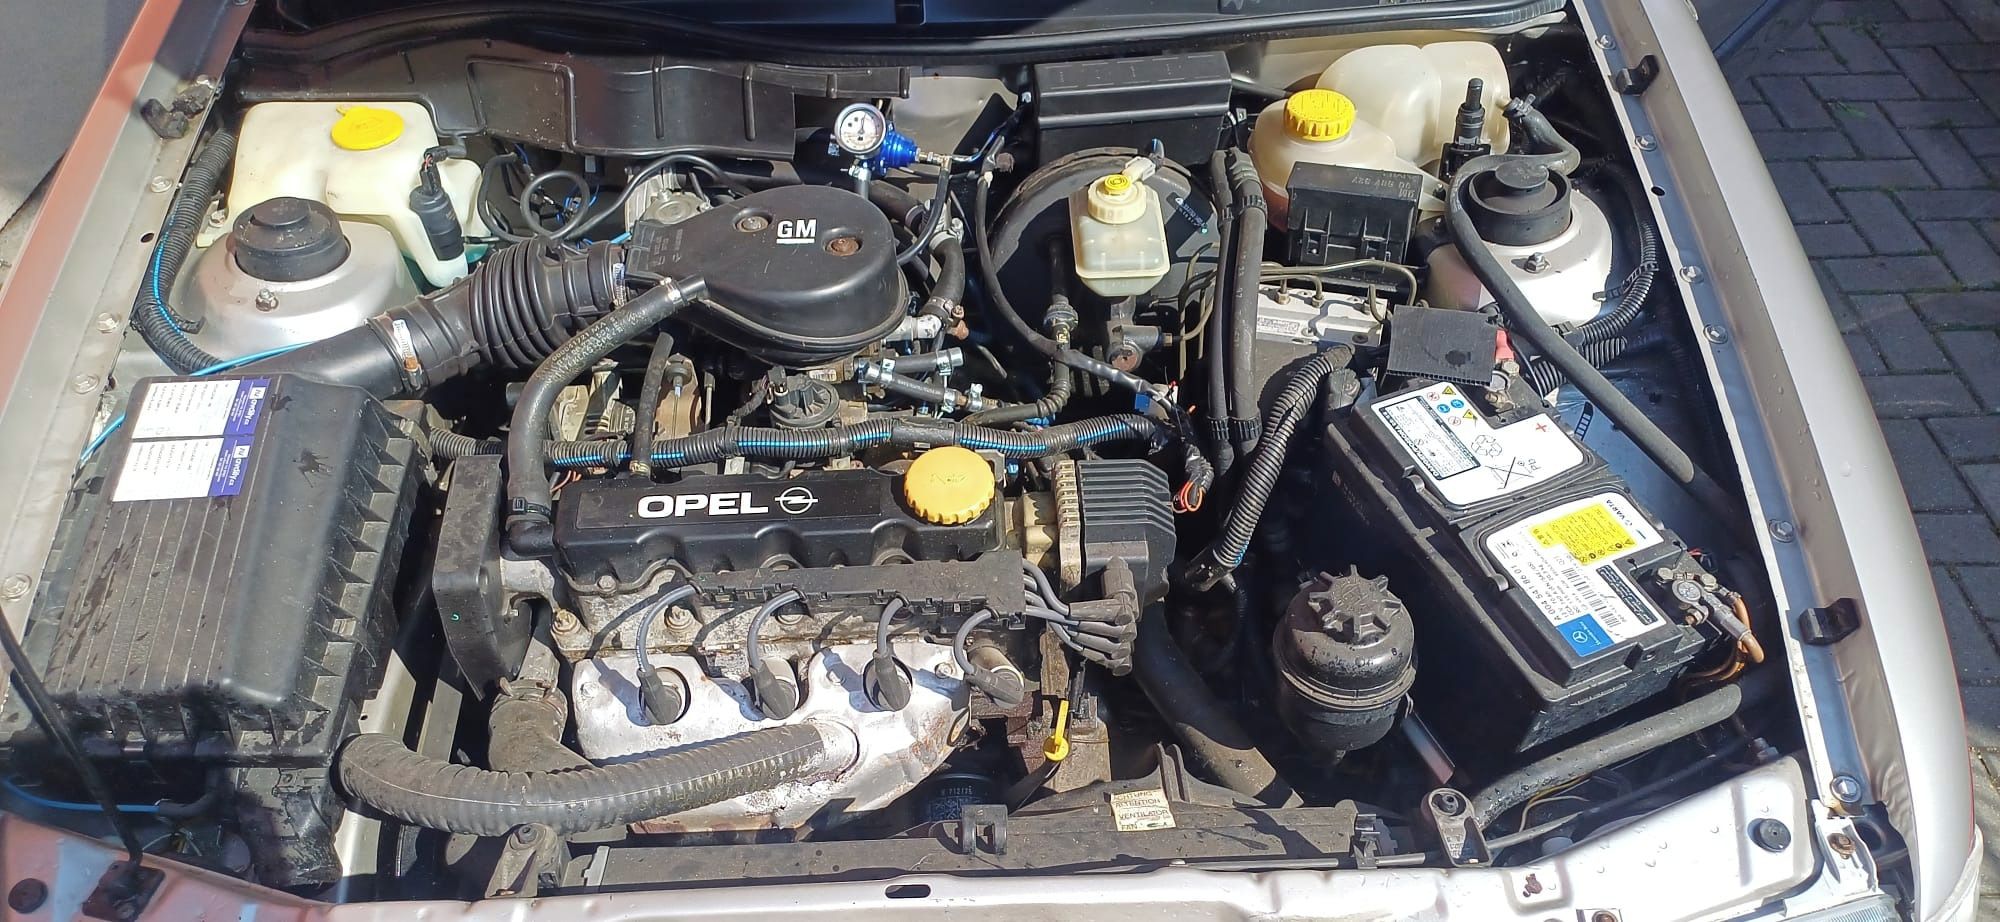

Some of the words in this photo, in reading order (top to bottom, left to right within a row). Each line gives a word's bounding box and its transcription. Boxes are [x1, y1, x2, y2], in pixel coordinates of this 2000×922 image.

[777, 218, 816, 238] GM
[638, 492, 768, 518] OPEL
[1606, 498, 1625, 520] VARTA
[1528, 584, 1543, 600] 541
[1540, 599, 1556, 615] 004
